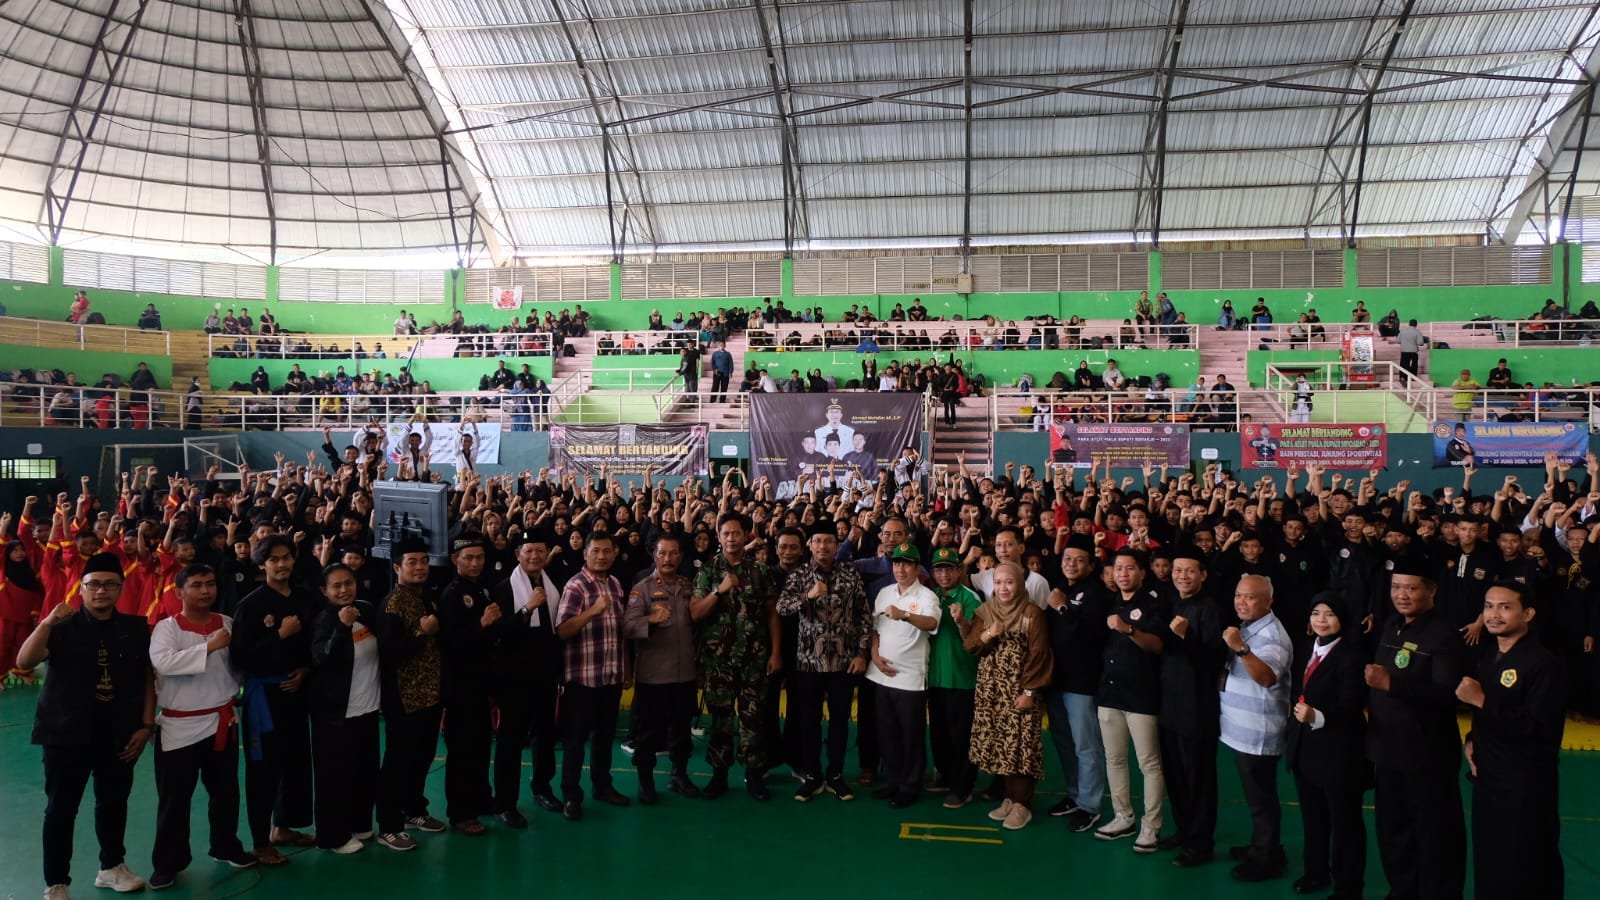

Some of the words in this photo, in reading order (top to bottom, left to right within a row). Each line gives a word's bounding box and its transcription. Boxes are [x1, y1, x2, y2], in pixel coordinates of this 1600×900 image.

[1282, 428, 1310, 438] SELAMAT
[1312, 428, 1354, 438] BERTANDING
[568, 445, 616, 455] SELAMAT
